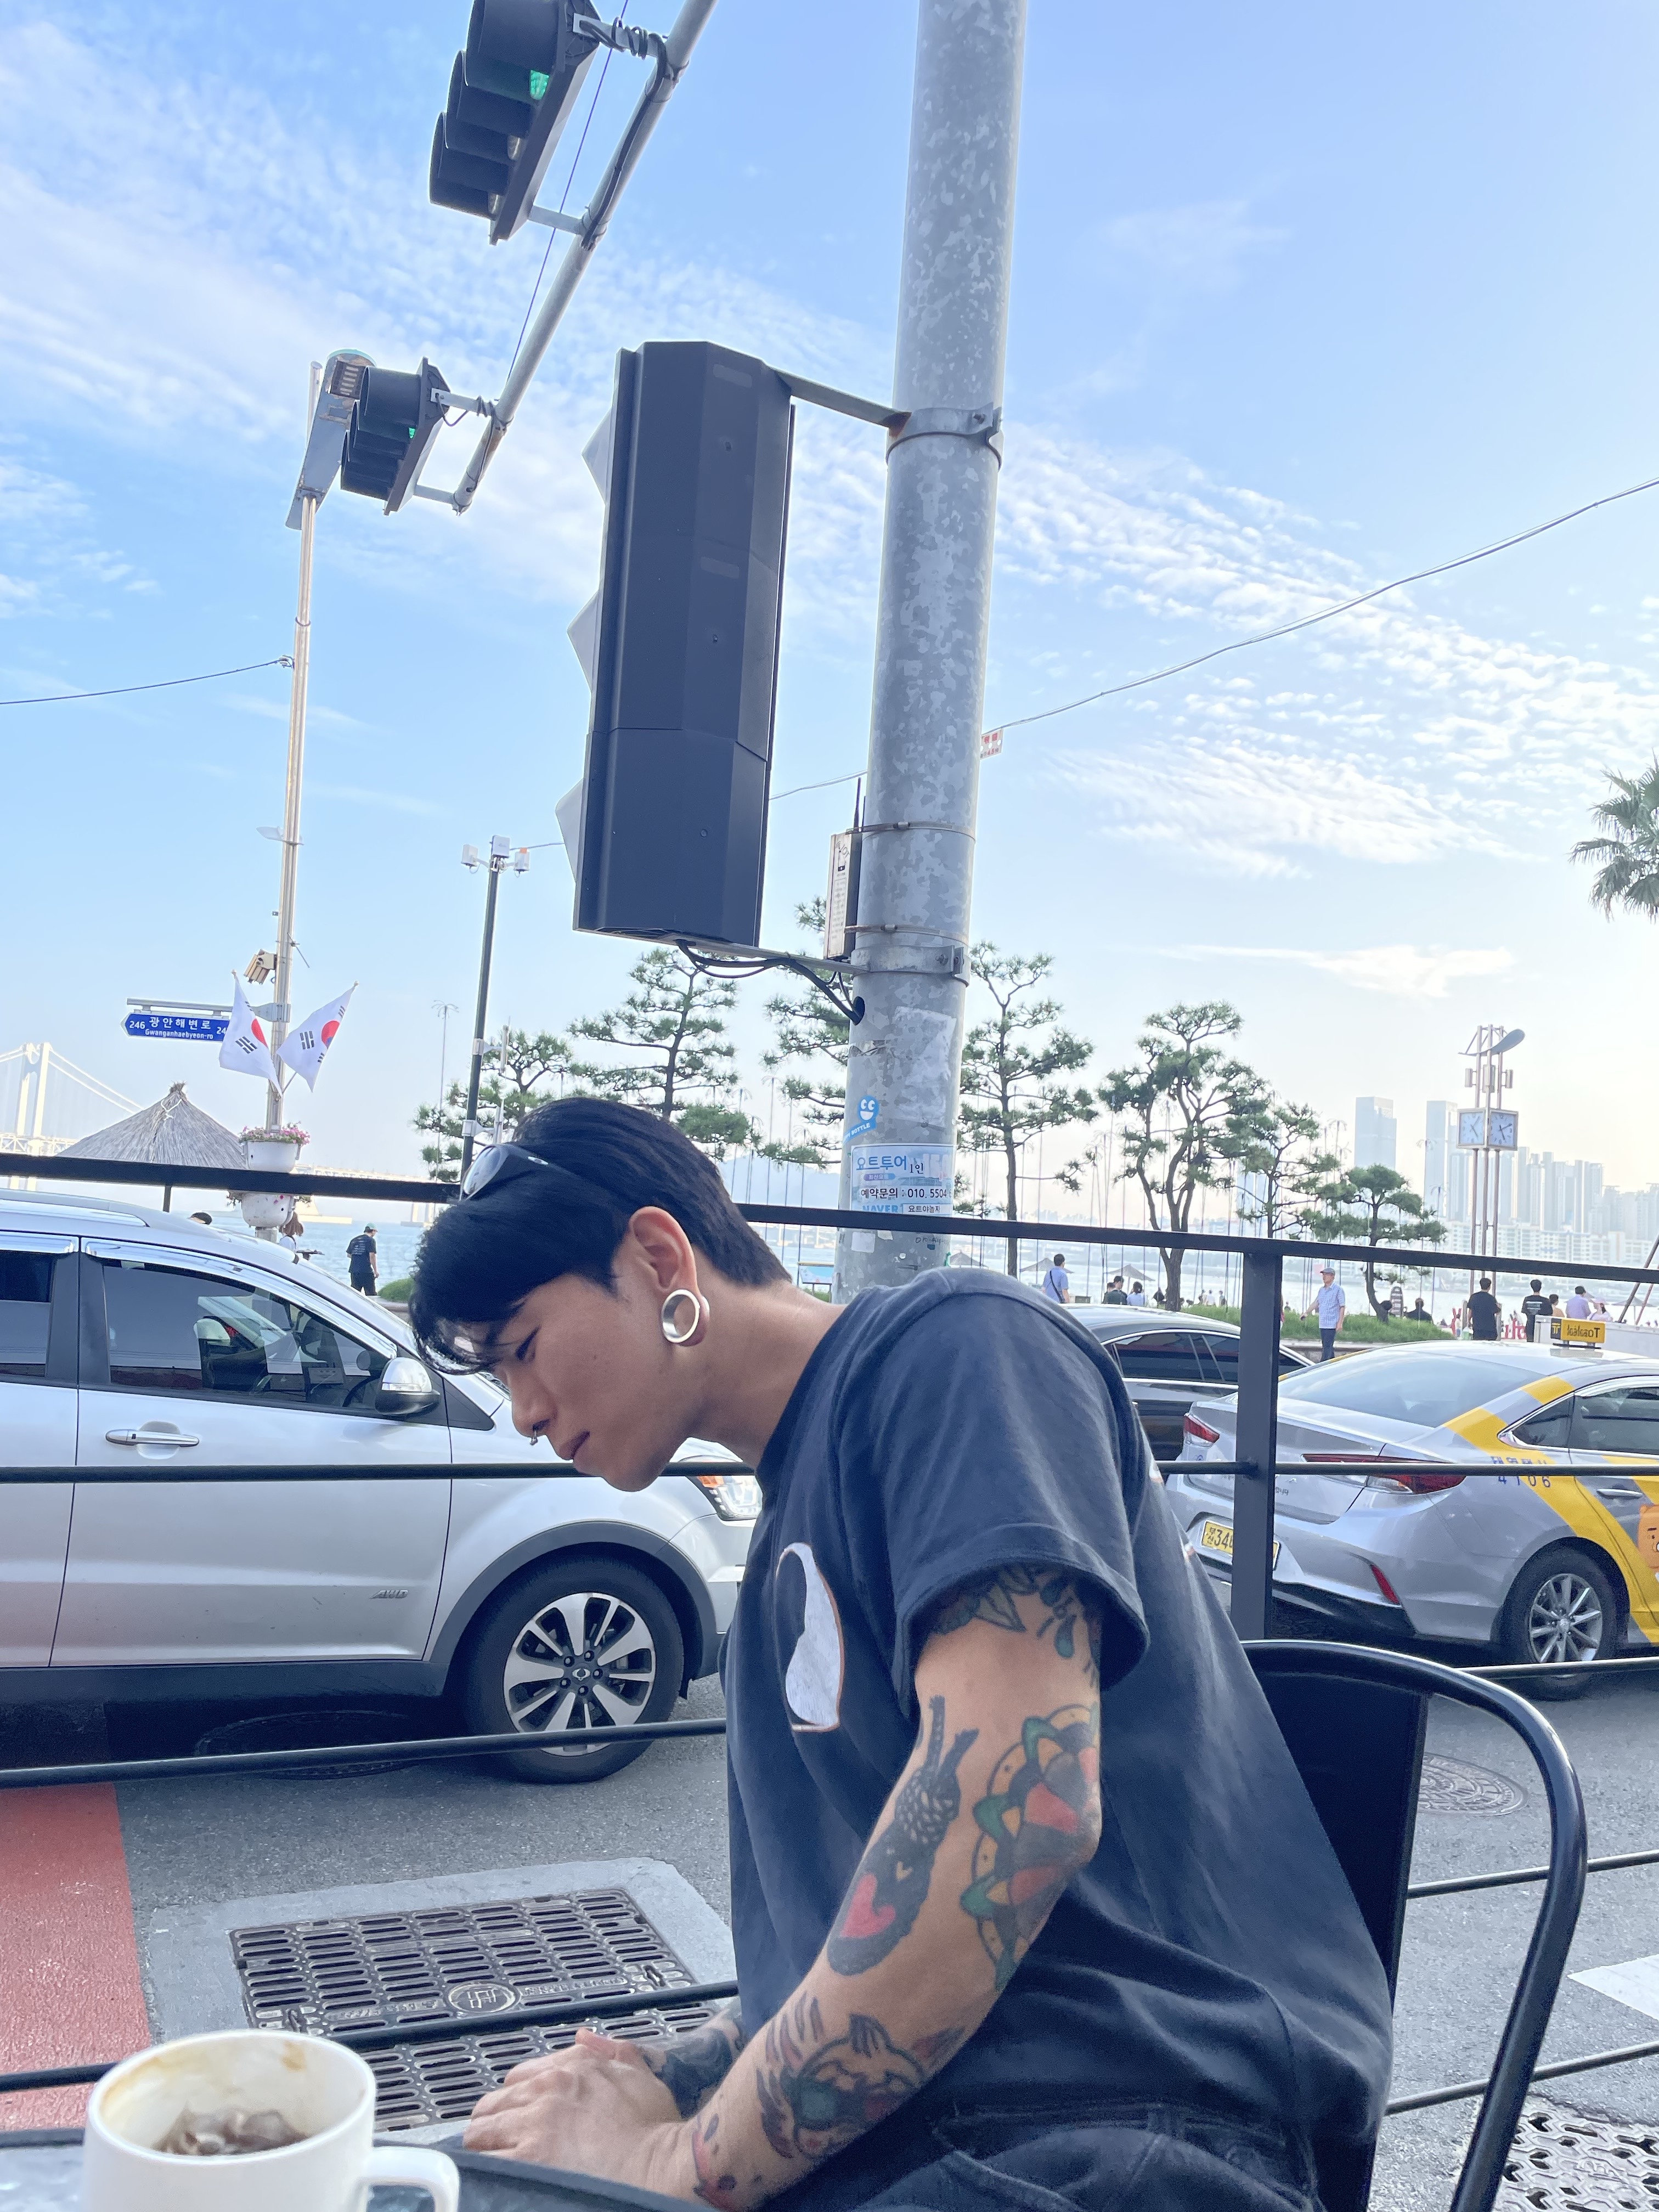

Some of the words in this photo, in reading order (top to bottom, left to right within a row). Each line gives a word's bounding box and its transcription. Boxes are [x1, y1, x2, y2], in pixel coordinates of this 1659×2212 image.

[129, 1020, 145, 1029] 246
[149, 1017, 211, 1030] 광안해변로
[145, 1029, 214, 1040] Gwanganhaebyeon-ro
[851, 1122, 871, 1136] BOTTLE
[856, 1155, 907, 1170] 요트투어
[861, 1188, 898, 1199] 예약문의
[862, 1205, 898, 1213] NAVER
